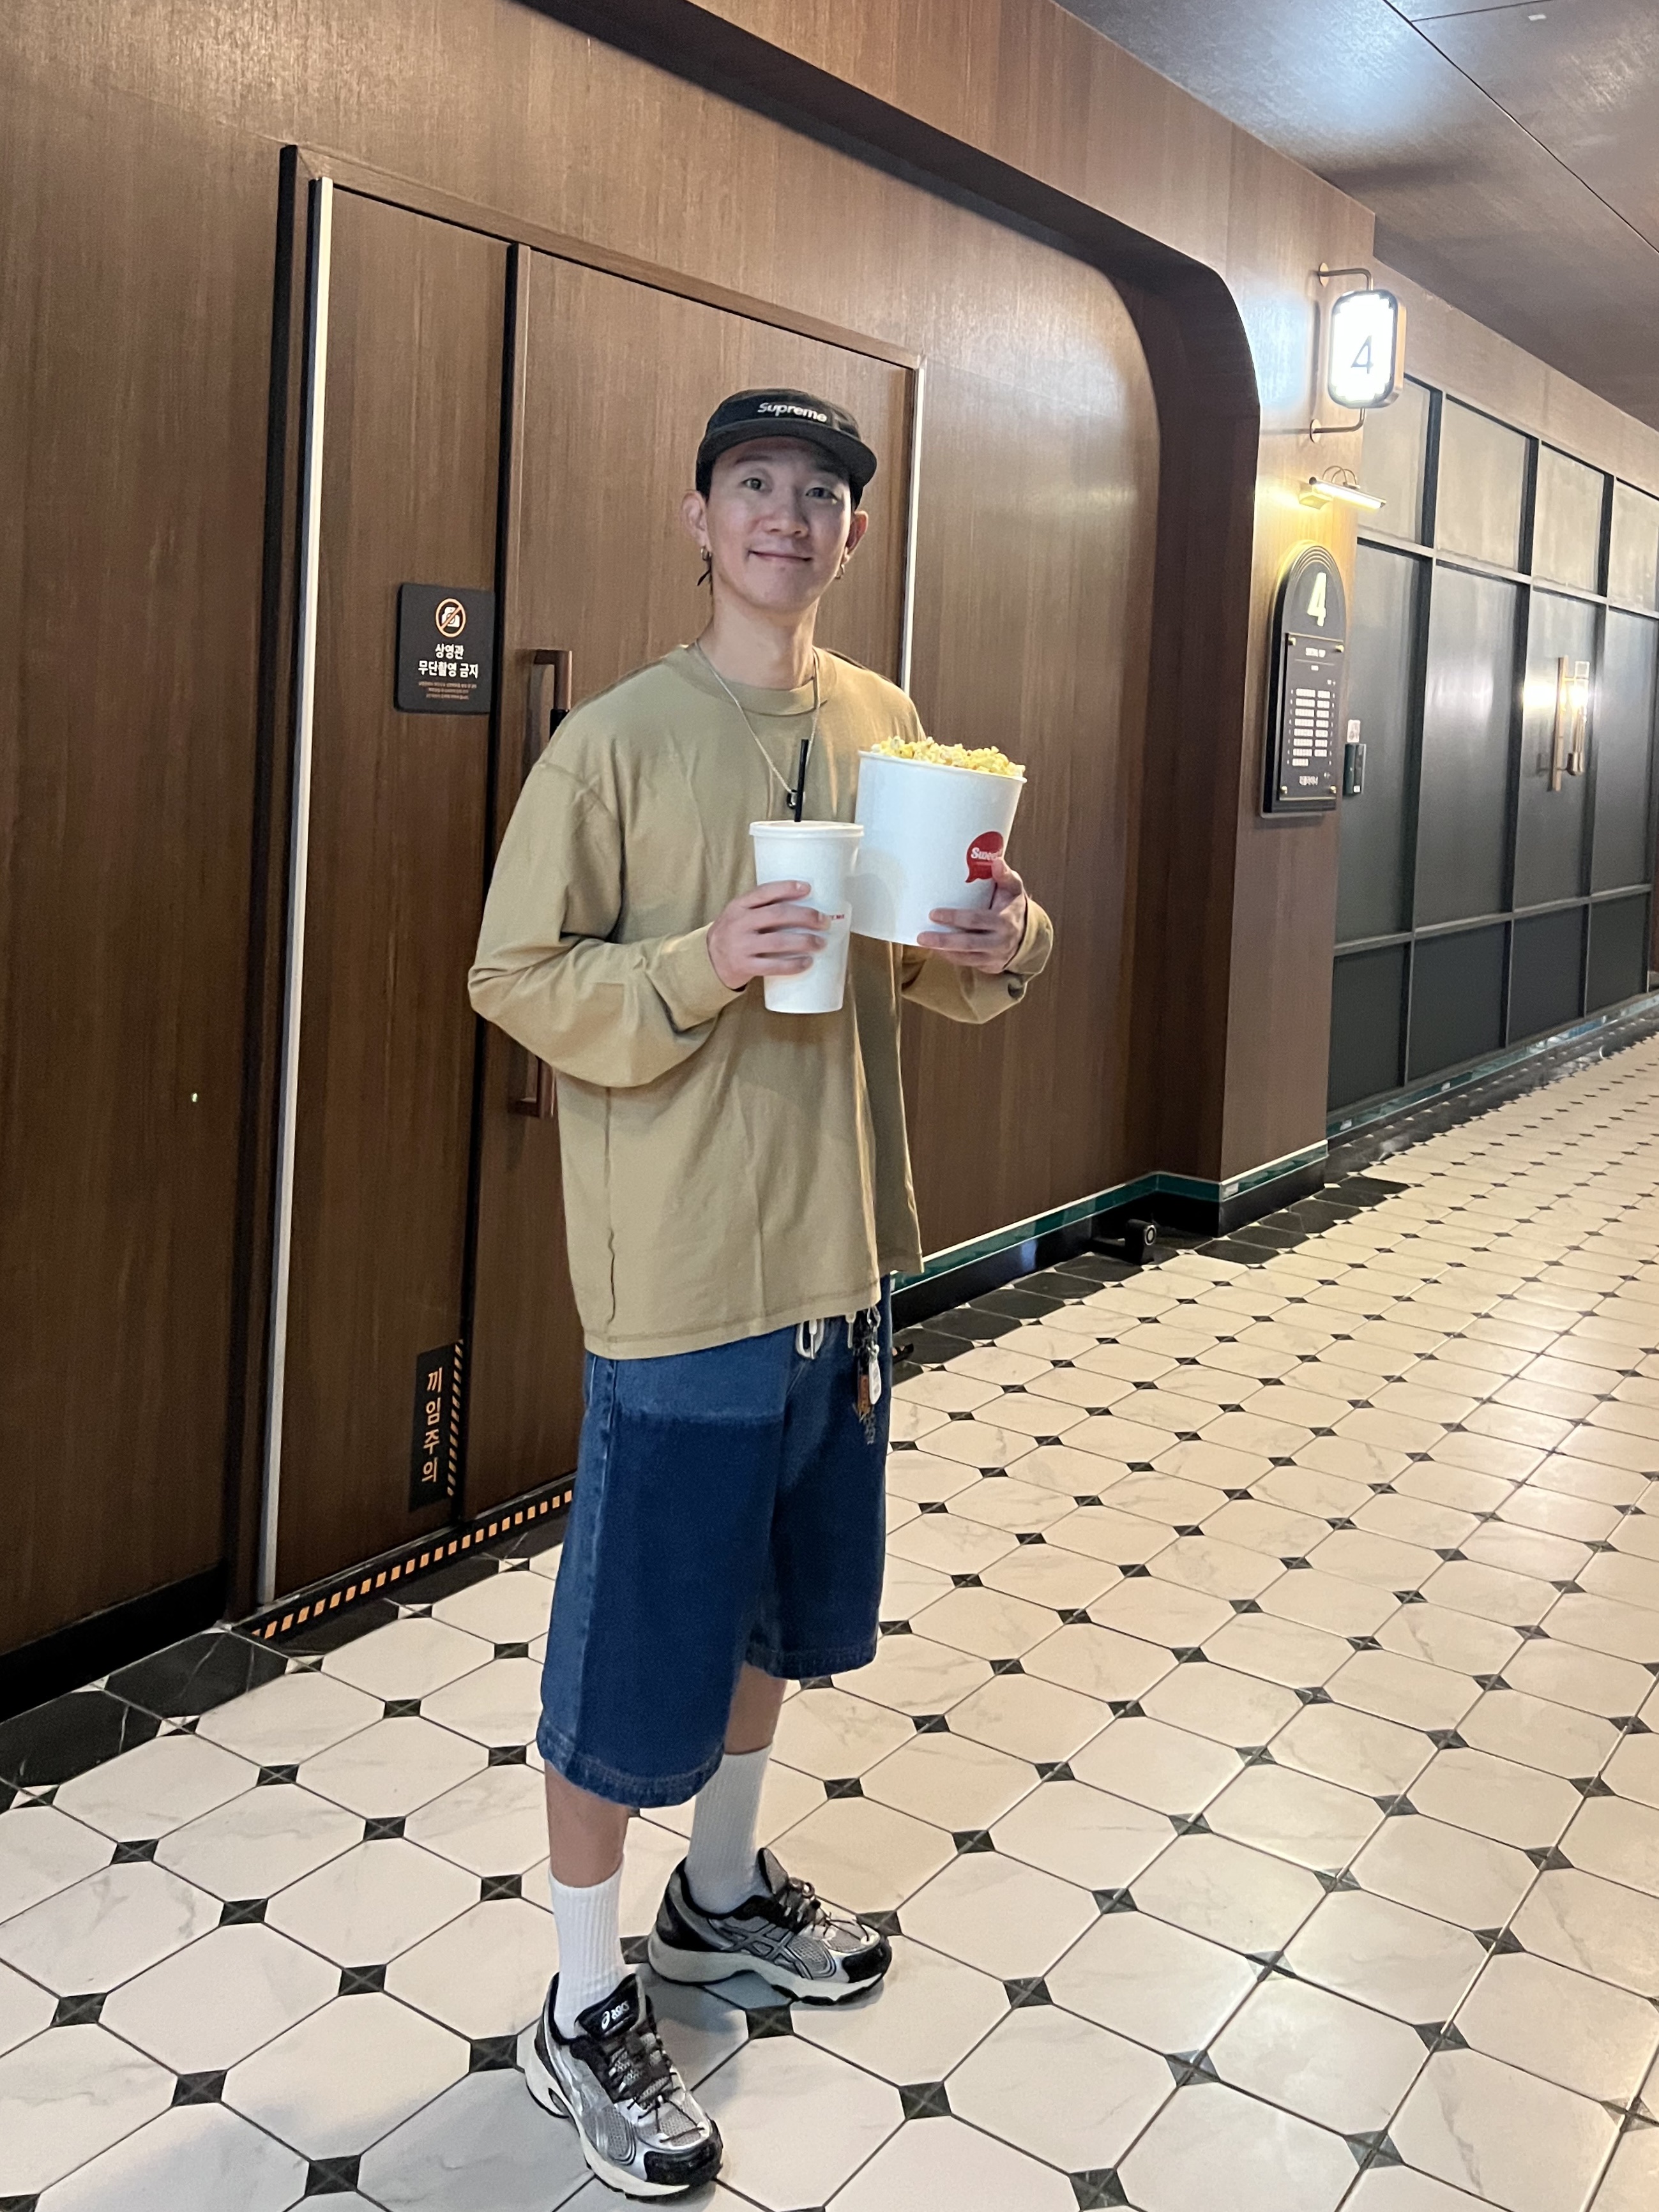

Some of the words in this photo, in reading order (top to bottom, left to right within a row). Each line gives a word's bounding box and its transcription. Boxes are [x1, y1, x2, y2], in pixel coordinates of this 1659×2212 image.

[1351, 335, 1374, 374] 4
[757, 402, 828, 423] Supreme
[1307, 571, 1328, 627] 4
[435, 643, 464, 660] 상영관
[418, 660, 457, 677] 무단촬영
[459, 663, 479, 679] 금지
[421, 1367, 443, 1483] 끼임주의
